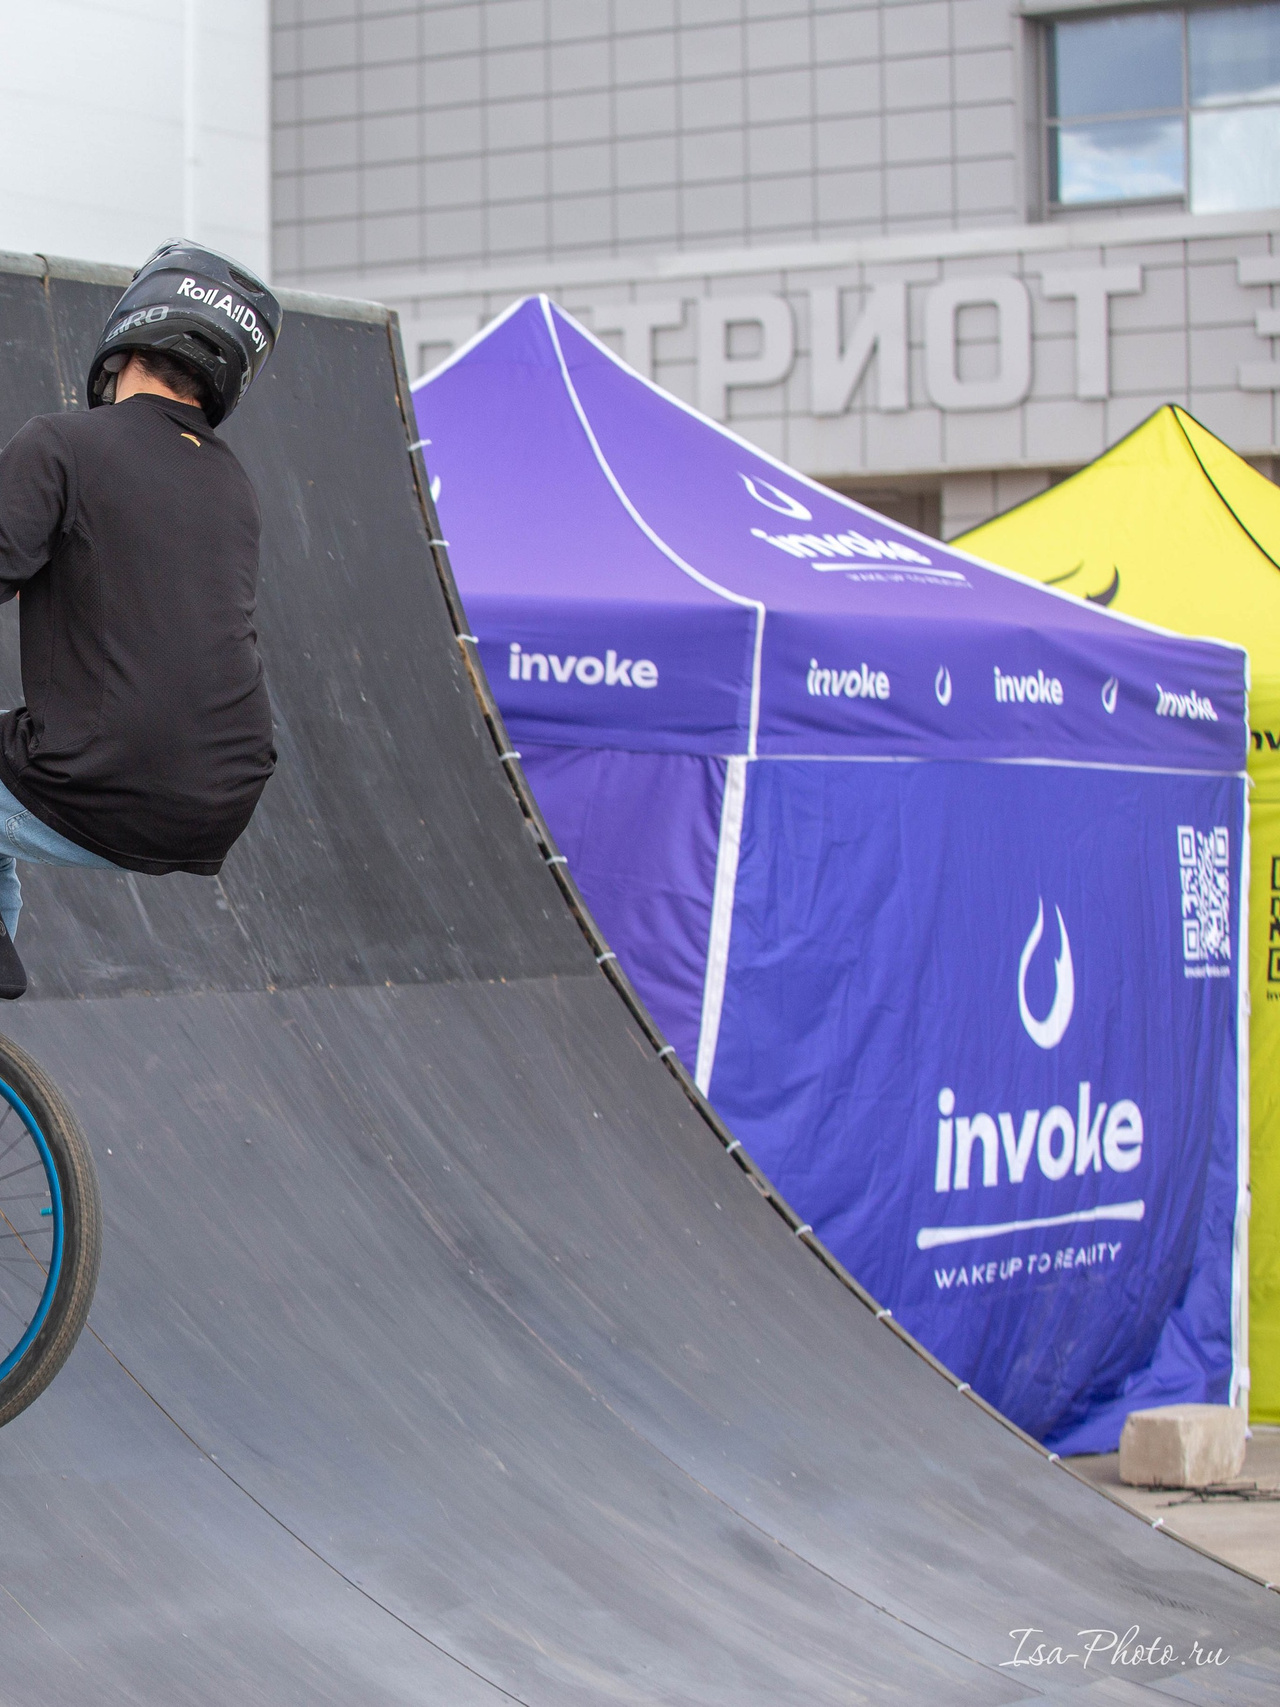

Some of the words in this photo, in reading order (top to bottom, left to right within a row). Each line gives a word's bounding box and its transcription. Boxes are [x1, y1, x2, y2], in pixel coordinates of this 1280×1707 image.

[404, 264, 1144, 419] ТРИОТ
[509, 642, 659, 689] invoke
[806, 657, 891, 701] invoke
[993, 665, 1064, 706] invoke
[1155, 682, 1219, 722] invoke
[934, 1080, 1144, 1193] invoke
[933, 1261, 998, 1290] WAKE
[999, 1256, 1023, 1281] UP
[1026, 1252, 1052, 1275] TO
